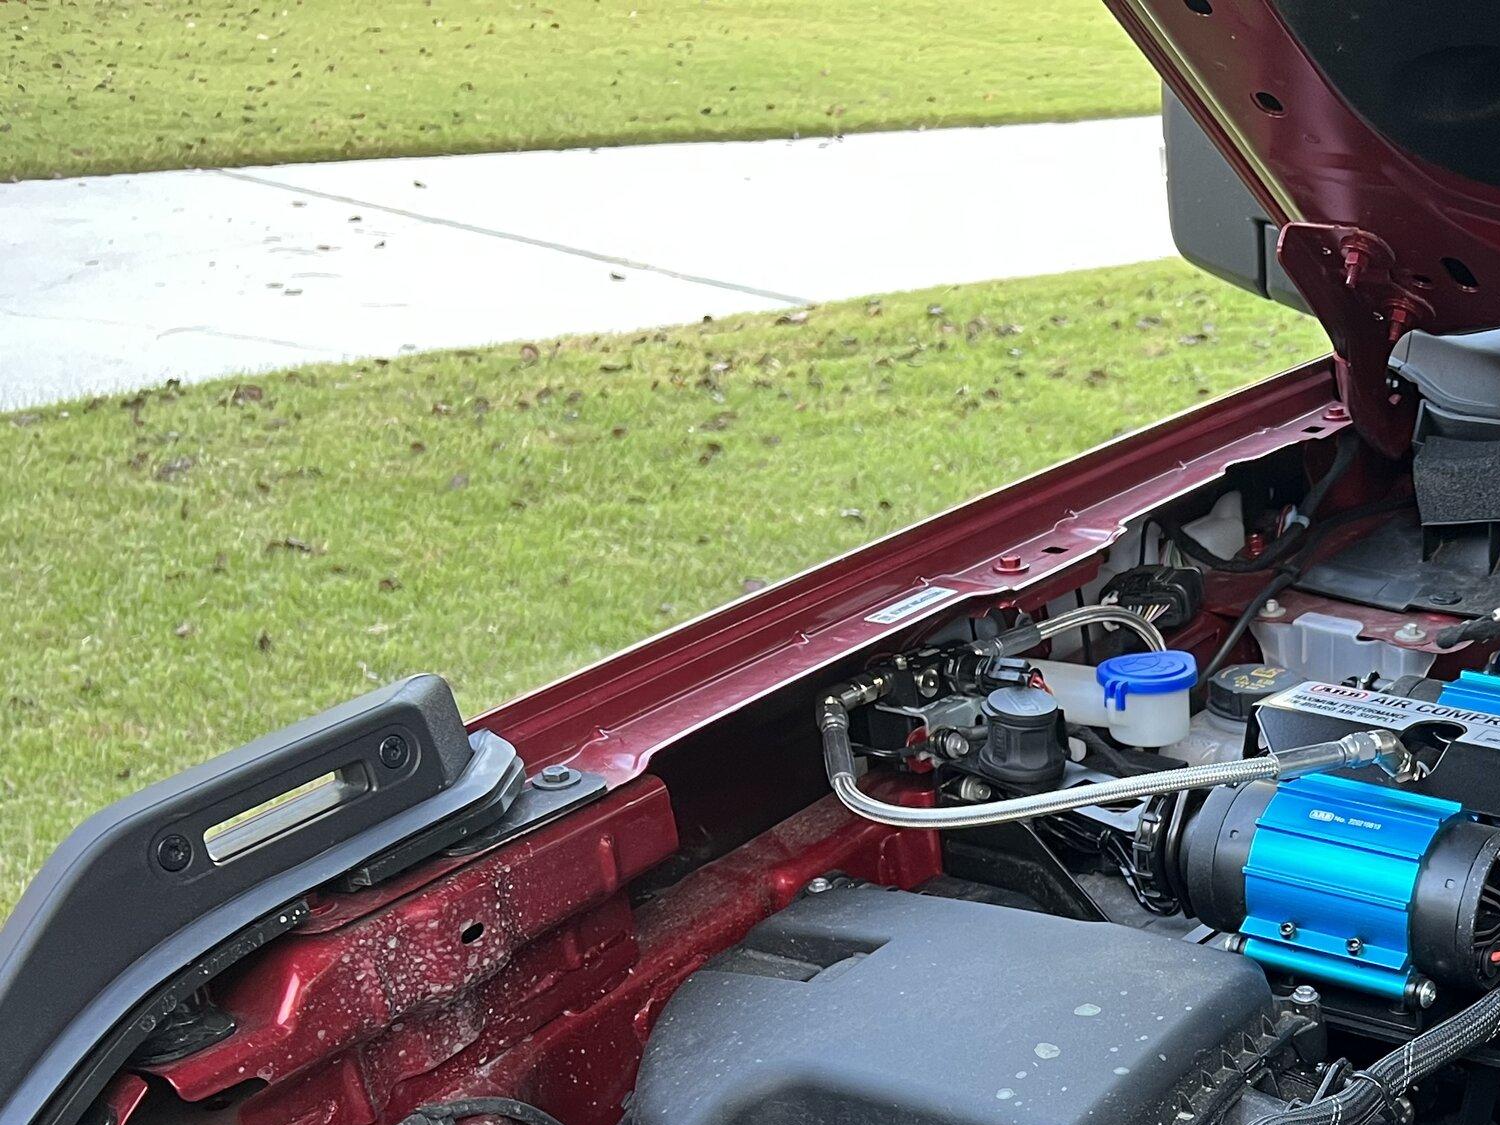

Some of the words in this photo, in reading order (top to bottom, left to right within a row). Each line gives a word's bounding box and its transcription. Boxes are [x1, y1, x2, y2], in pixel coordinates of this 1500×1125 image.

[1371, 696, 1412, 709] AIR
[1338, 707, 1356, 716] AIR
[1358, 711, 1399, 724] SUPPLY
[1340, 703, 1410, 720] PERFORMANCE
